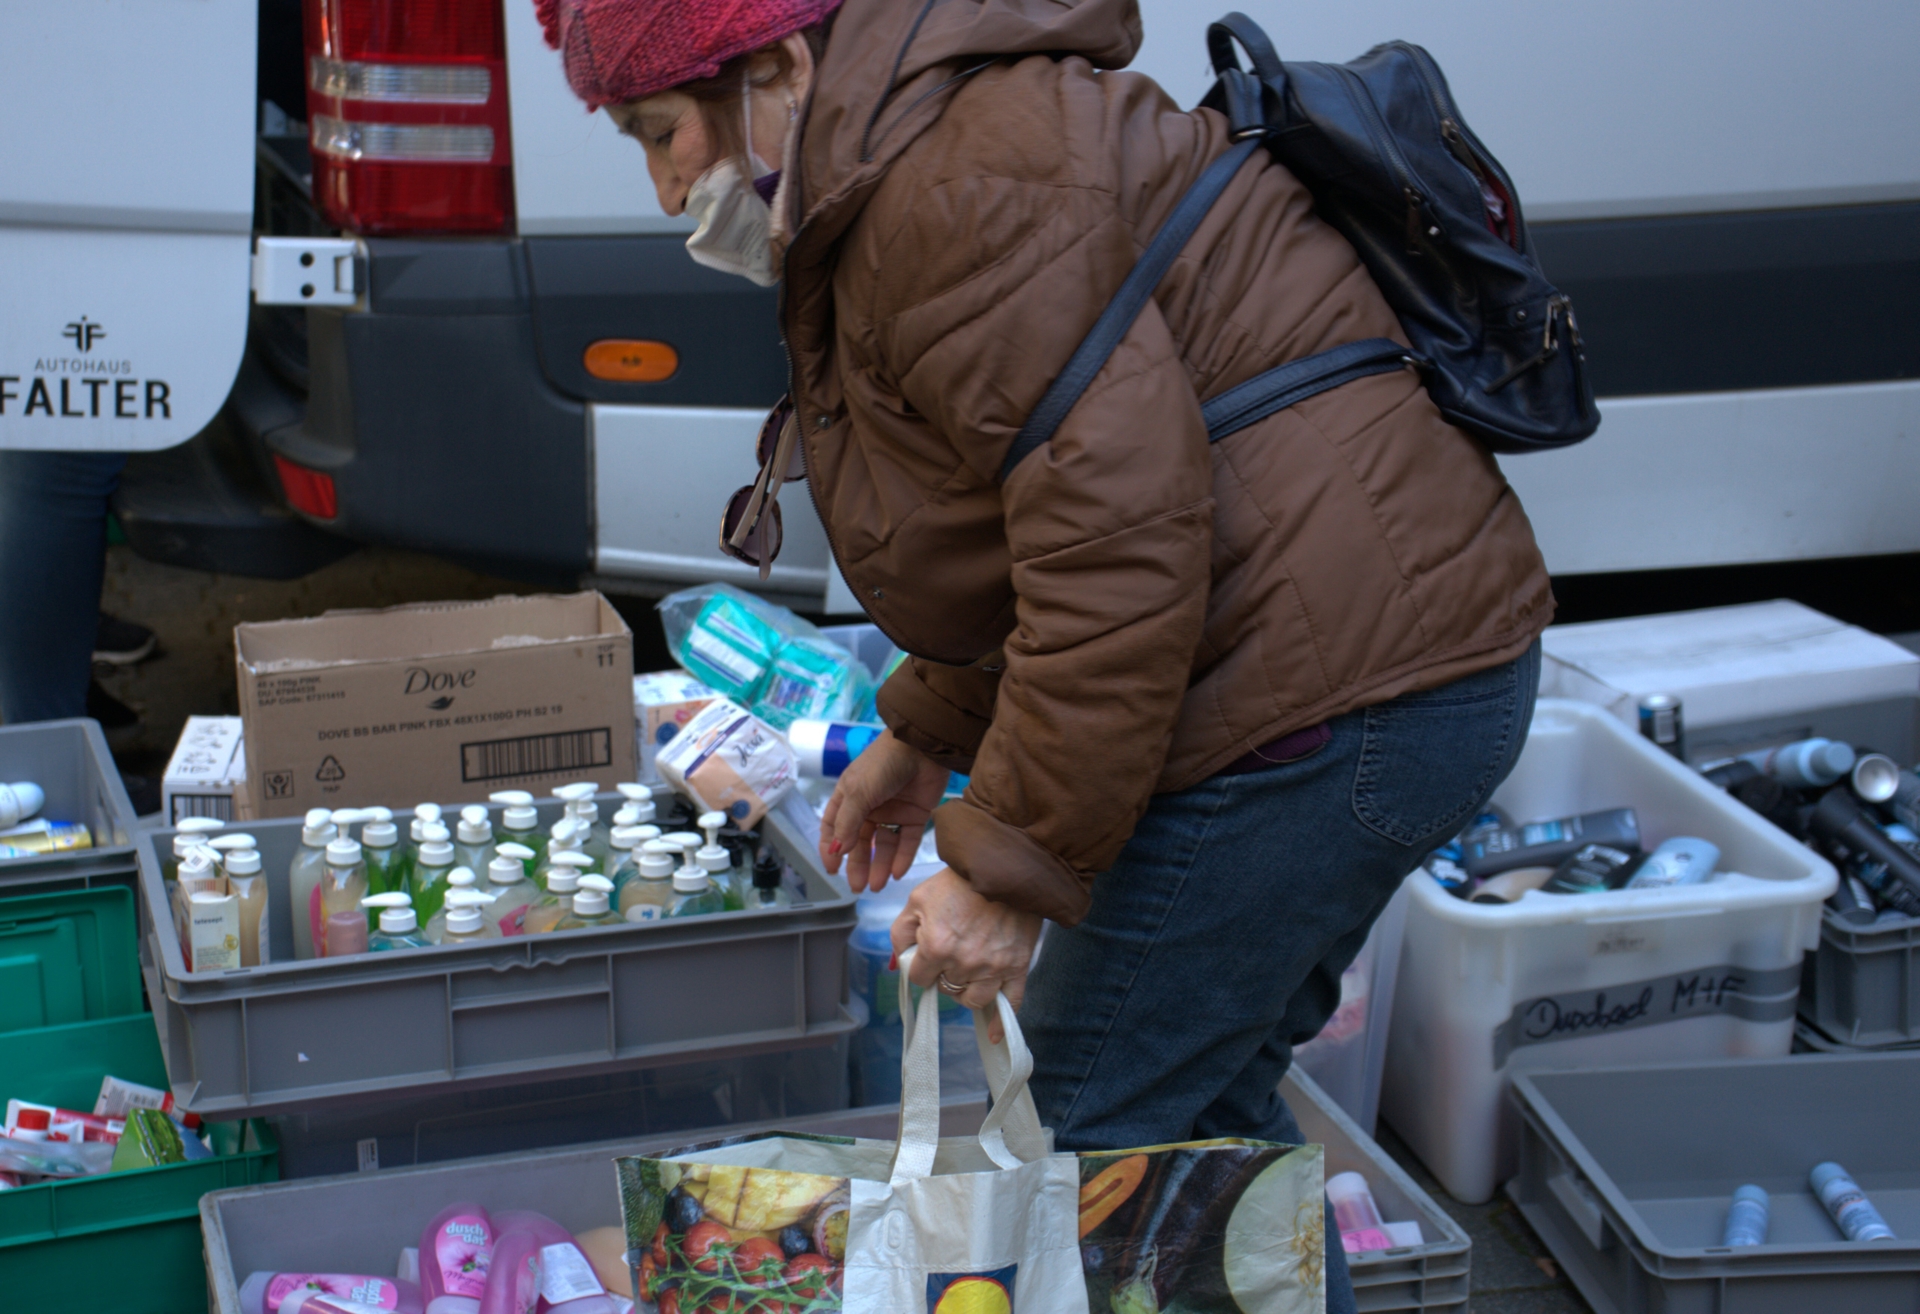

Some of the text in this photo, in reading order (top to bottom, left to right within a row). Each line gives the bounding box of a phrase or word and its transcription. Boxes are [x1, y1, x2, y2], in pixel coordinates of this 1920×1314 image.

[35, 357, 131, 374] AUTOHAUS
[0, 376, 171, 419] FALTER
[404, 666, 476, 695] Dove
[318, 727, 351, 741] DOVE
[372, 723, 397, 735] BAR
[399, 721, 427, 732] PINK
[428, 718, 451, 728] FBX
[516, 708, 532, 718] PH
[446, 1221, 484, 1237] dusch
[462, 1233, 486, 1247] das
